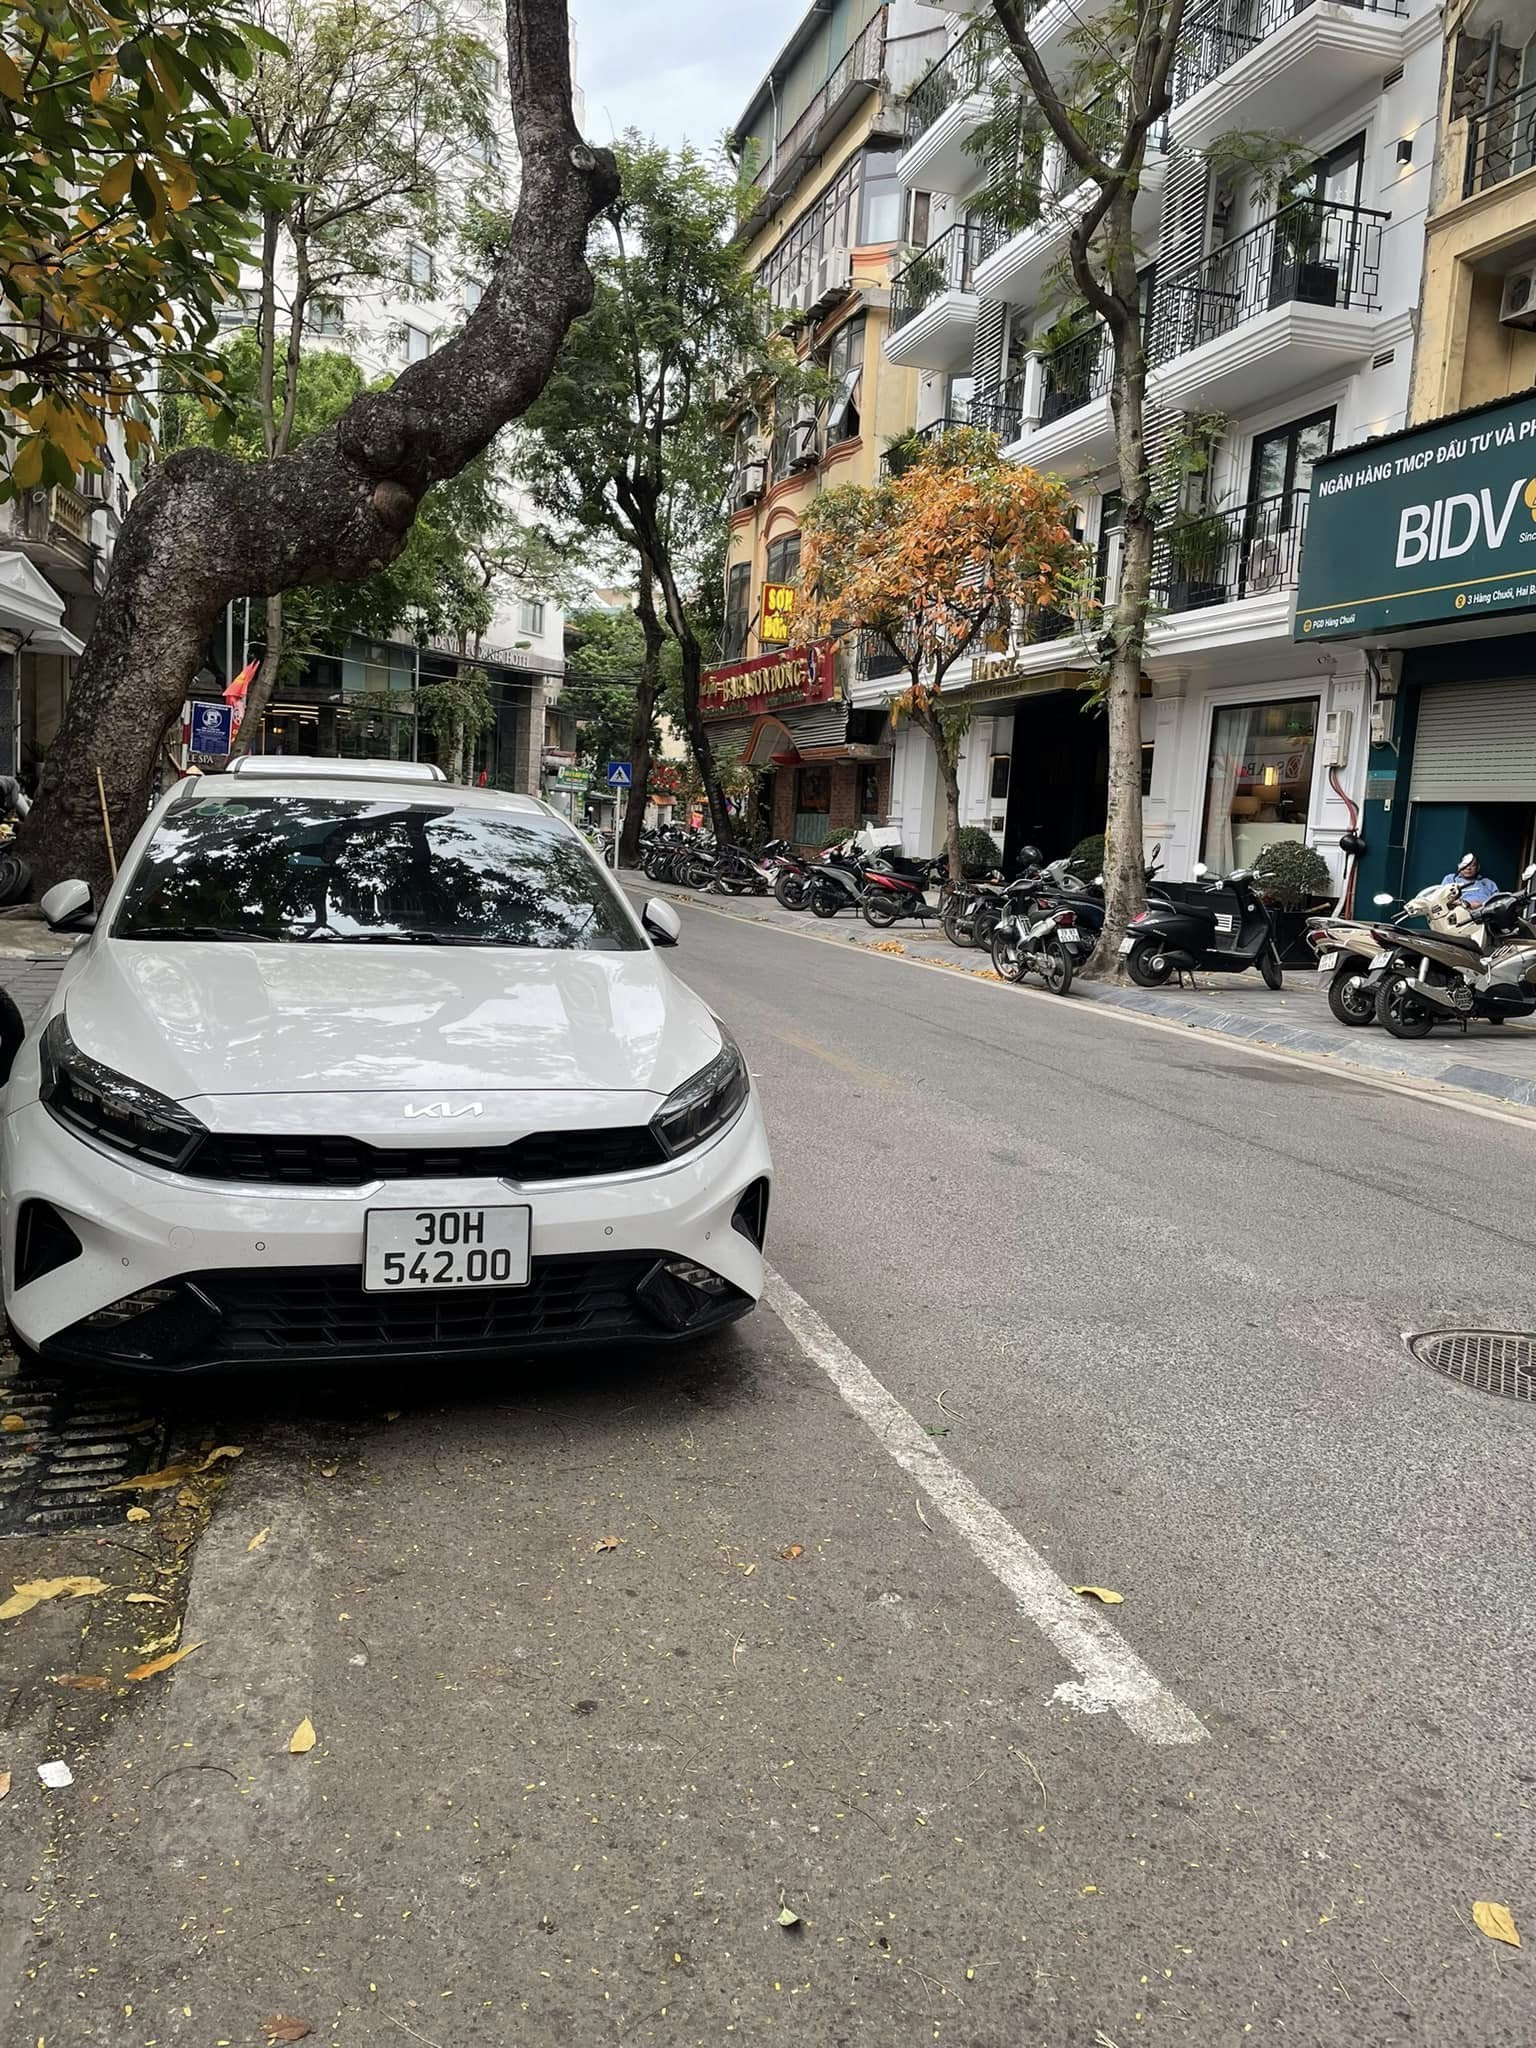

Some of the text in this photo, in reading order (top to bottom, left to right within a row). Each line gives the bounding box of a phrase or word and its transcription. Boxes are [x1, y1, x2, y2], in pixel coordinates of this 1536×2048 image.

[1318, 473, 1353, 498] NGÂN
[1355, 462, 1392, 487] HÀNG
[1394, 449, 1434, 476] TMCP
[1436, 438, 1467, 464] ĐẦU
[1470, 430, 1494, 454] TƯ
[1495, 421, 1516, 447] VÀ
[1395, 477, 1528, 569] BIDV
[1467, 595, 1473, 605] 3
[1473, 593, 1492, 604] Hàng
[1515, 585, 1529, 597] Hai
[404, 1102, 484, 1118] KIA
[415, 1211, 485, 1246] 30H
[383, 1248, 512, 1286] 542.00
